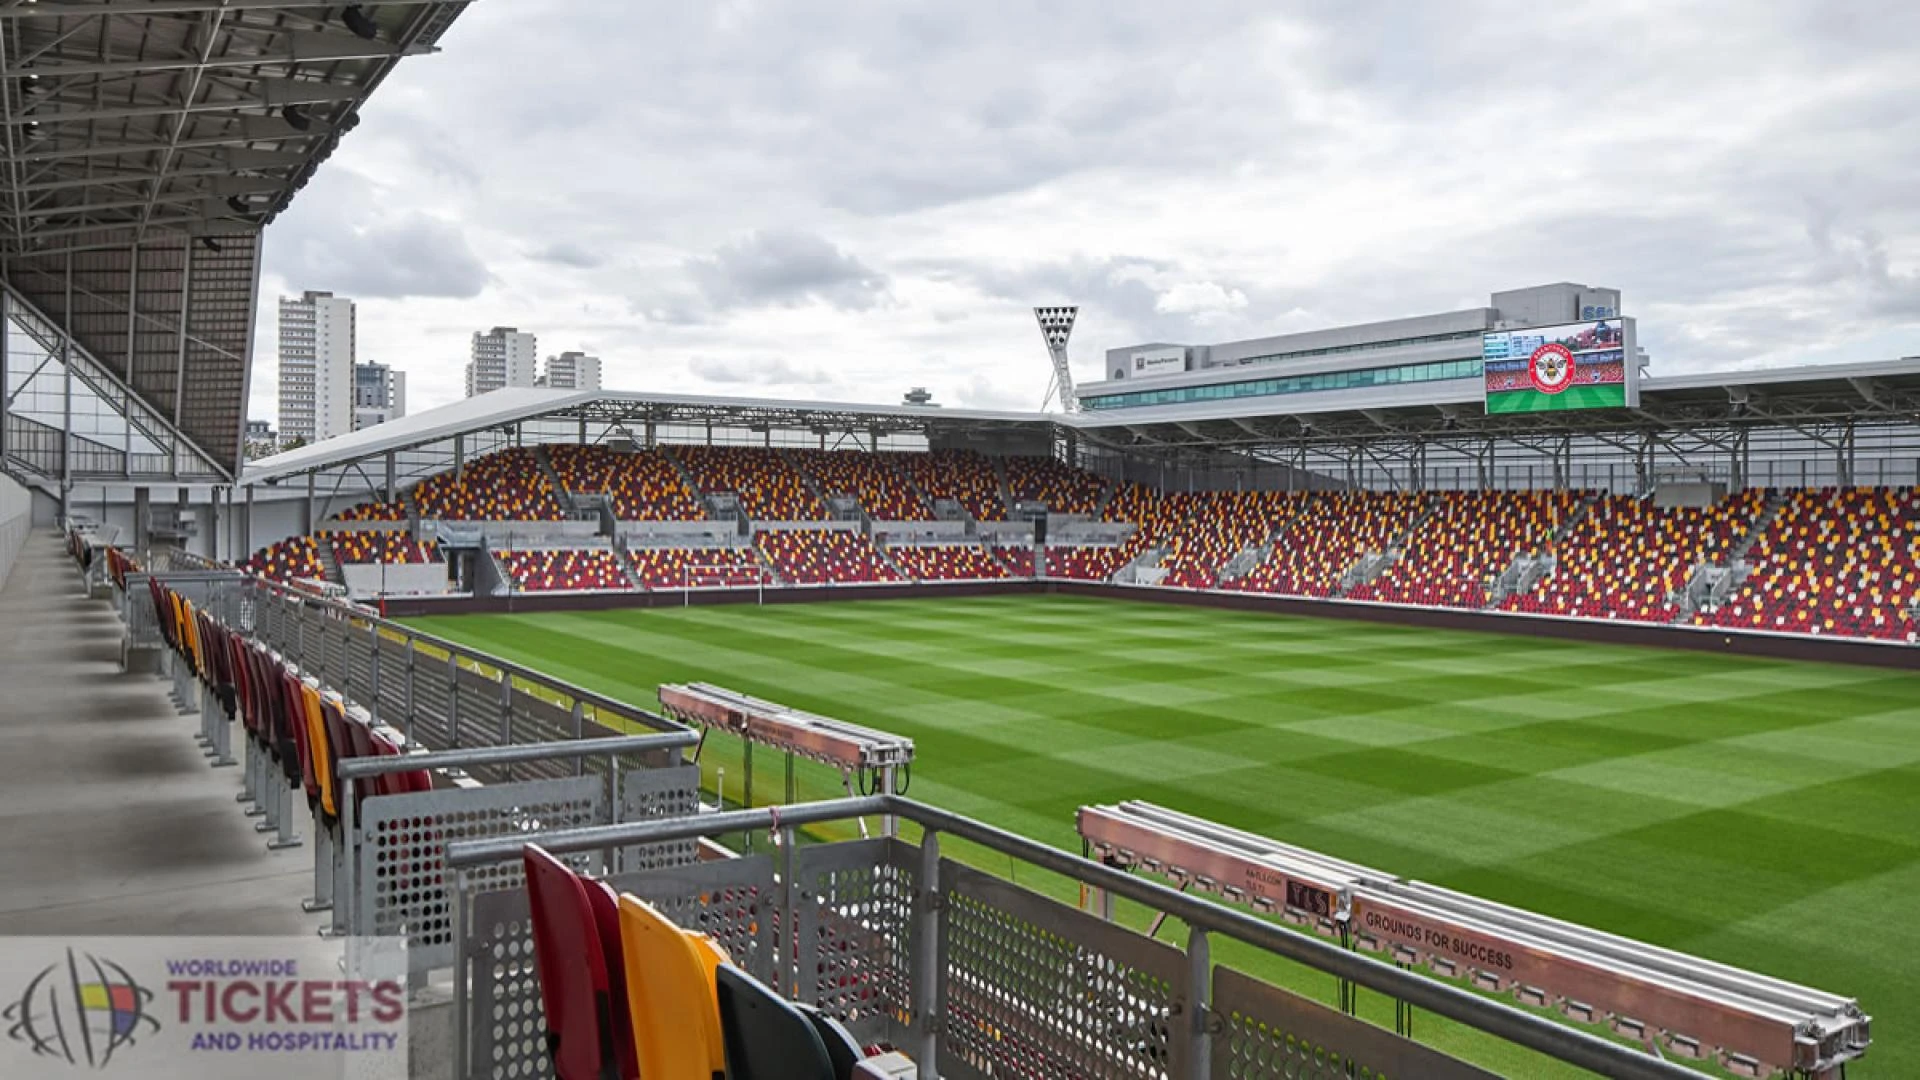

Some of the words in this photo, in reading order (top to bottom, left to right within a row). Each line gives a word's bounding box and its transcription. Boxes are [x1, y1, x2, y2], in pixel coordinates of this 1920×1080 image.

[1365, 911, 1422, 941] GROUNDS
[1425, 929, 1449, 949] FOR
[1452, 938, 1513, 970] SUCCESS
